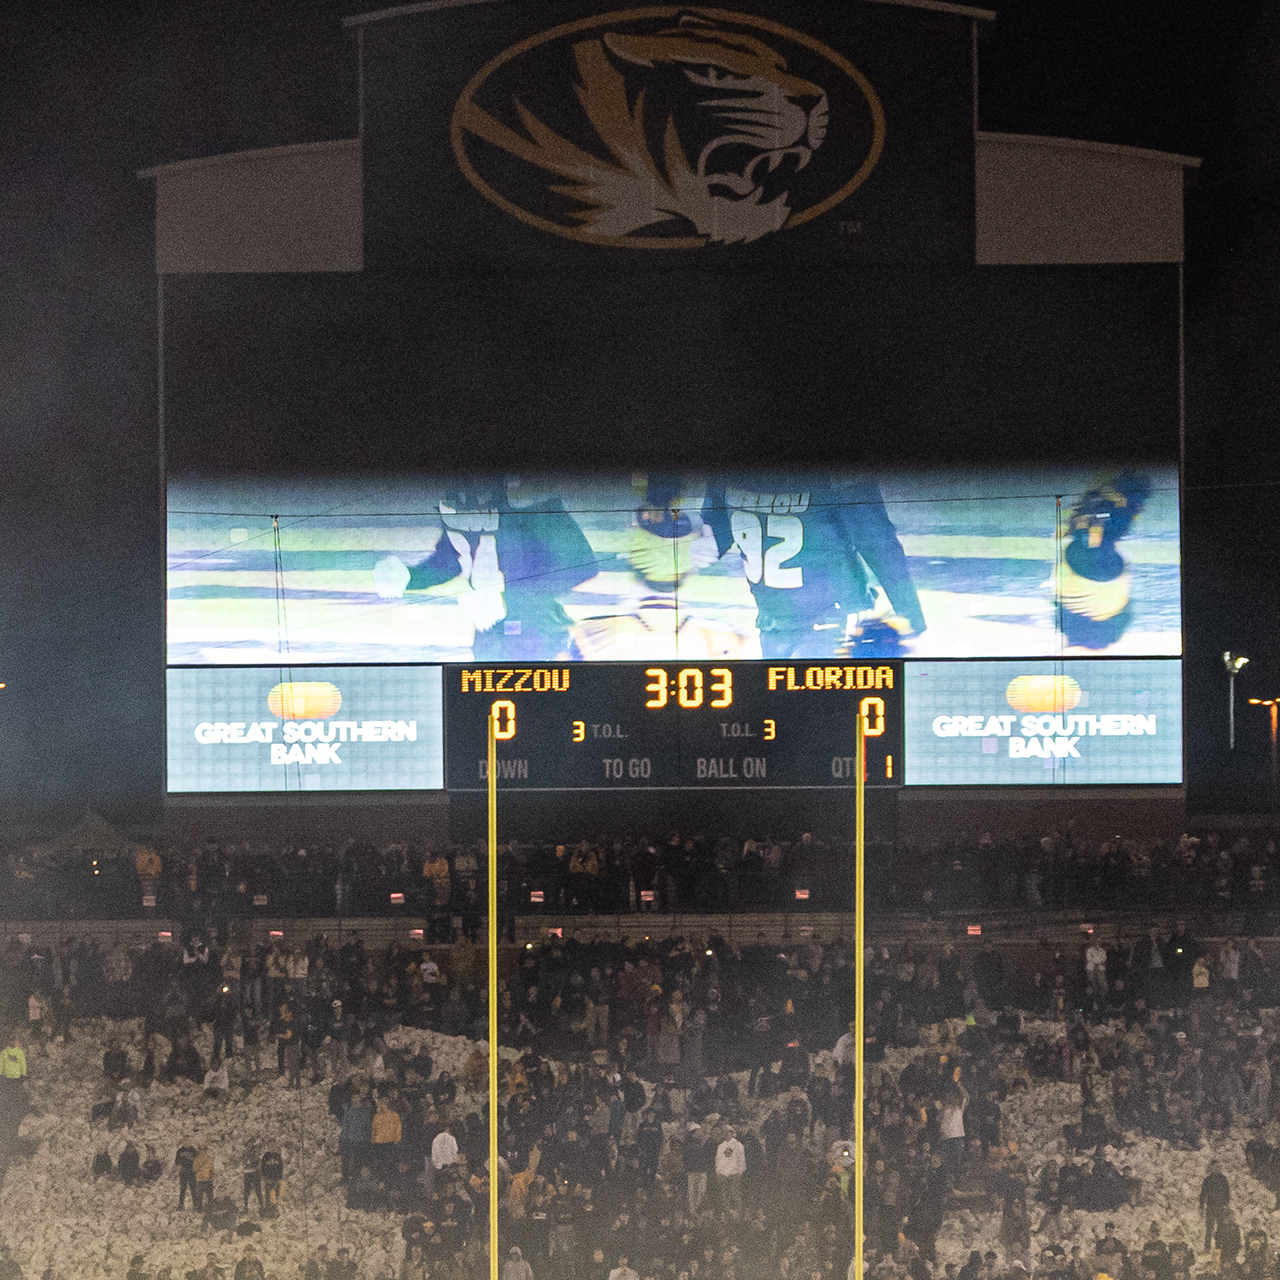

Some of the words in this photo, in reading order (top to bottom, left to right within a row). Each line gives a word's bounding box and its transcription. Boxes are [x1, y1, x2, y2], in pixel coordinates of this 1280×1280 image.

[730, 511, 804, 589] 92
[461, 669, 570, 692] MIZZOU
[645, 668, 733, 709] 3:03
[768, 666, 894, 690] FLORIDA
[491, 700, 516, 740] 0
[860, 697, 885, 737] 0
[932, 715, 1017, 737] GREAT
[1021, 714, 1156, 736] SOUTHERN
[195, 721, 278, 744] GREAT
[283, 720, 417, 743] SOUTHERN
[572, 720, 585, 742] 3
[591, 724, 629, 739] T.O.L.
[720, 723, 757, 738] T.O.L.
[764, 719, 776, 740] 3
[271, 743, 342, 765] BANK
[1009, 737, 1081, 758] BANK
[603, 759, 623, 778] TO
[629, 758, 651, 778] GO
[697, 758, 738, 779] BALL
[743, 758, 766, 778] ON
[831, 757, 867, 777] QT
[886, 754, 893, 779] 1
